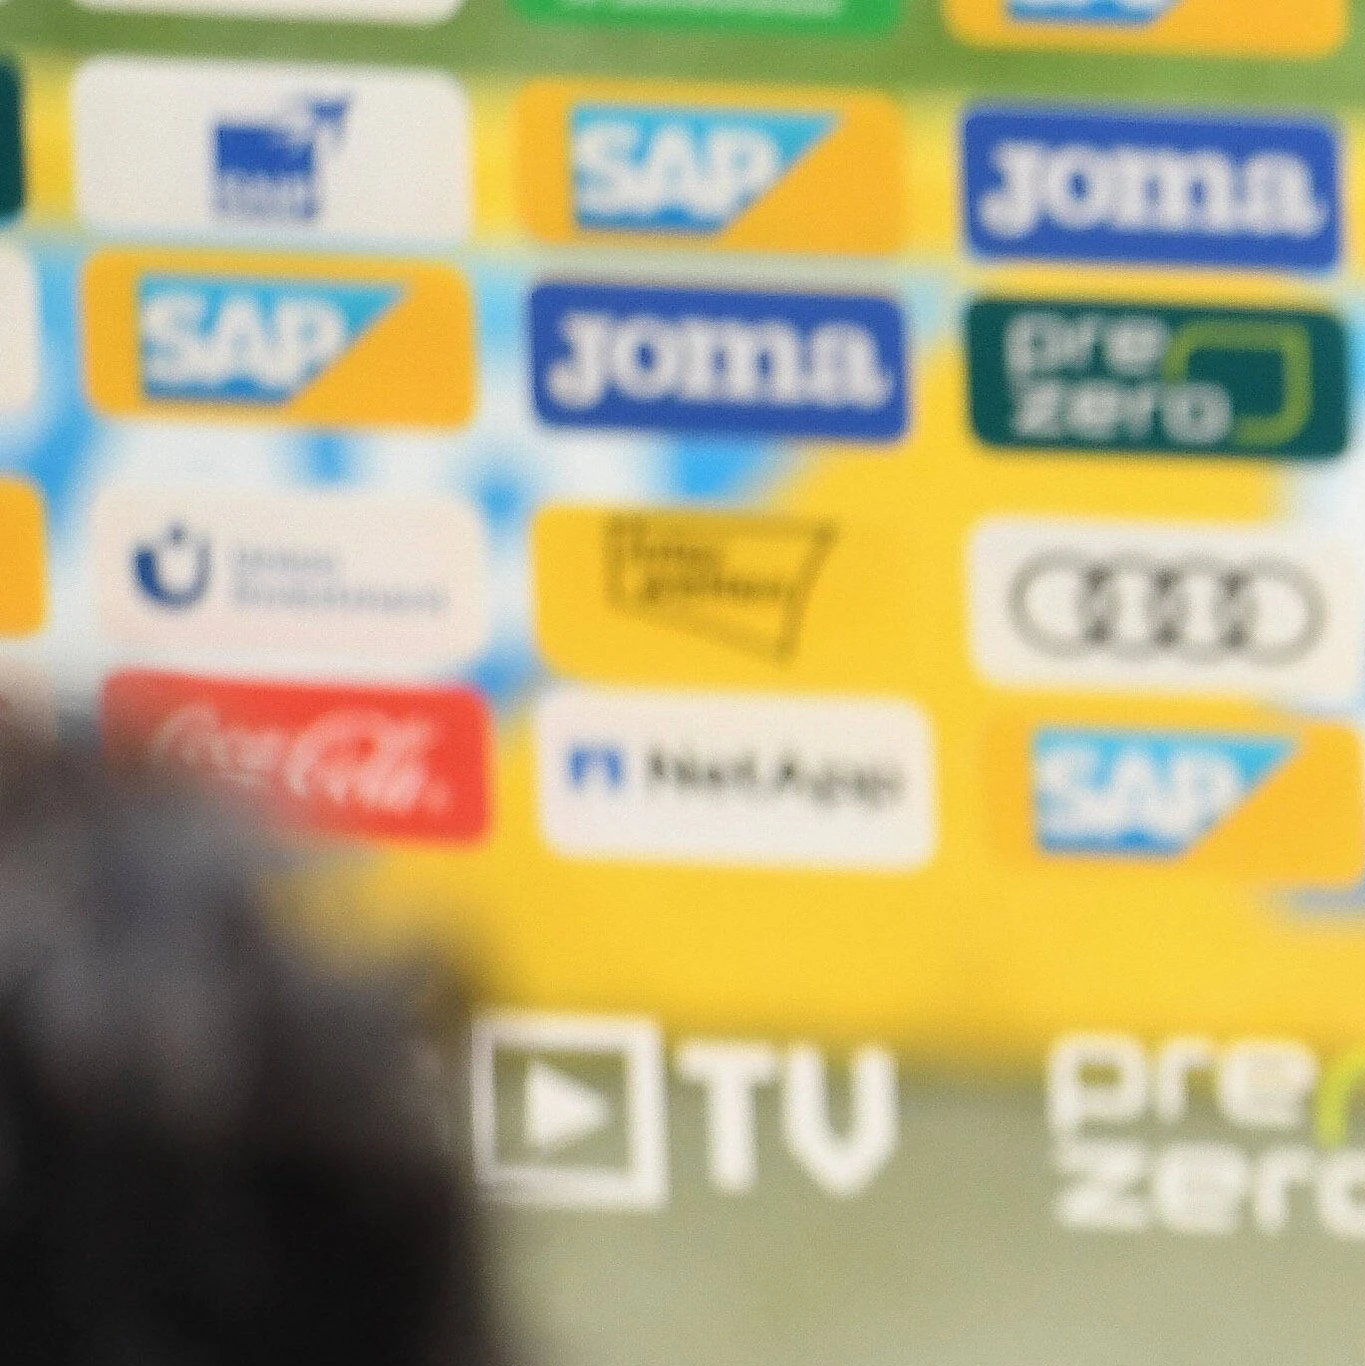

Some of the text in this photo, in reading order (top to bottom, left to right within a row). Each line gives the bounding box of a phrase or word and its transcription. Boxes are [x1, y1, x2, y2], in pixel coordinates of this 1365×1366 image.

[573, 116, 784, 222] SAP
[141, 286, 348, 394] SAP
[1005, 312, 1168, 382] pre
[1012, 378, 1234, 446] zero
[1036, 746, 1242, 842] SAP
[673, 1036, 897, 1197] TV
[1046, 1031, 1321, 1142] pre
